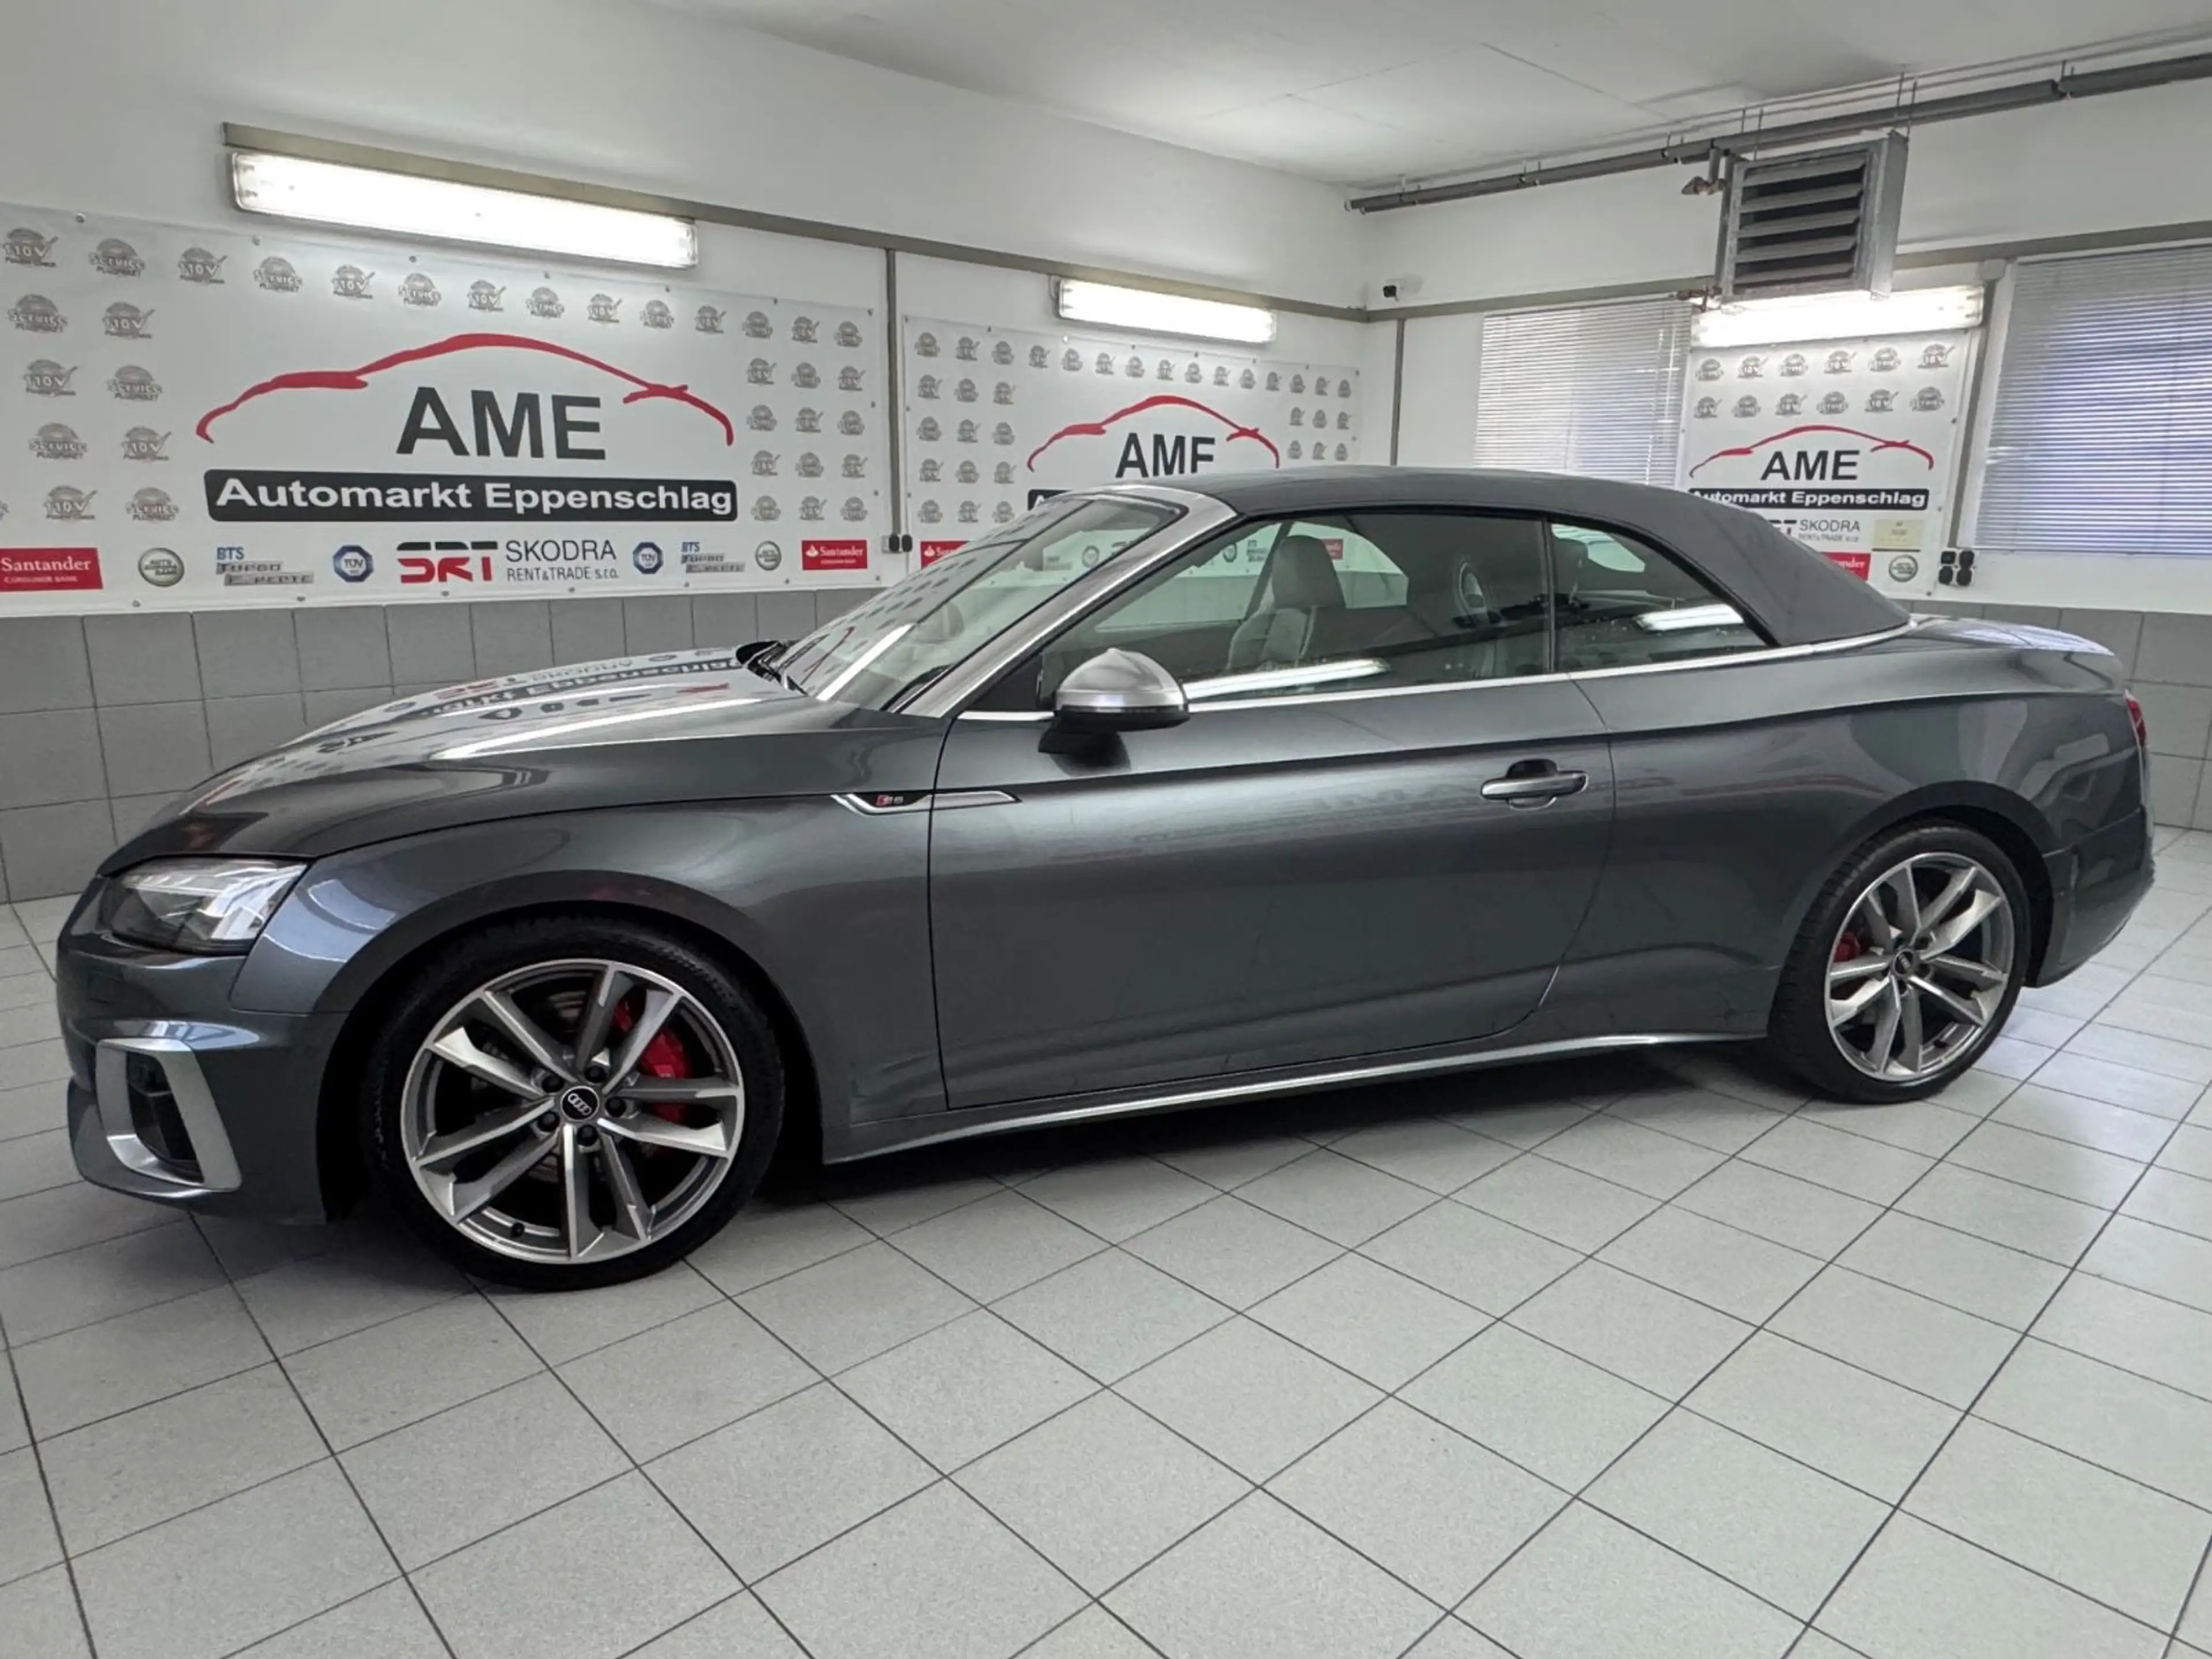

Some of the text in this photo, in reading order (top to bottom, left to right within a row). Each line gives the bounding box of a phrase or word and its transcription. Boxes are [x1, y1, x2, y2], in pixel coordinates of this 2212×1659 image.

[397, 387, 605, 460] AME
[1761, 450, 1859, 480] AME
[217, 479, 731, 514] Automarkt Eppenschlag
[1791, 491, 1925, 507] Eppenschlag
[1800, 520, 1860, 532] SKODRA
[217, 547, 244, 560] BTS
[505, 539, 617, 563] SKODRA
[819, 545, 863, 556] Santander
[1, 555, 91, 572] Santander
